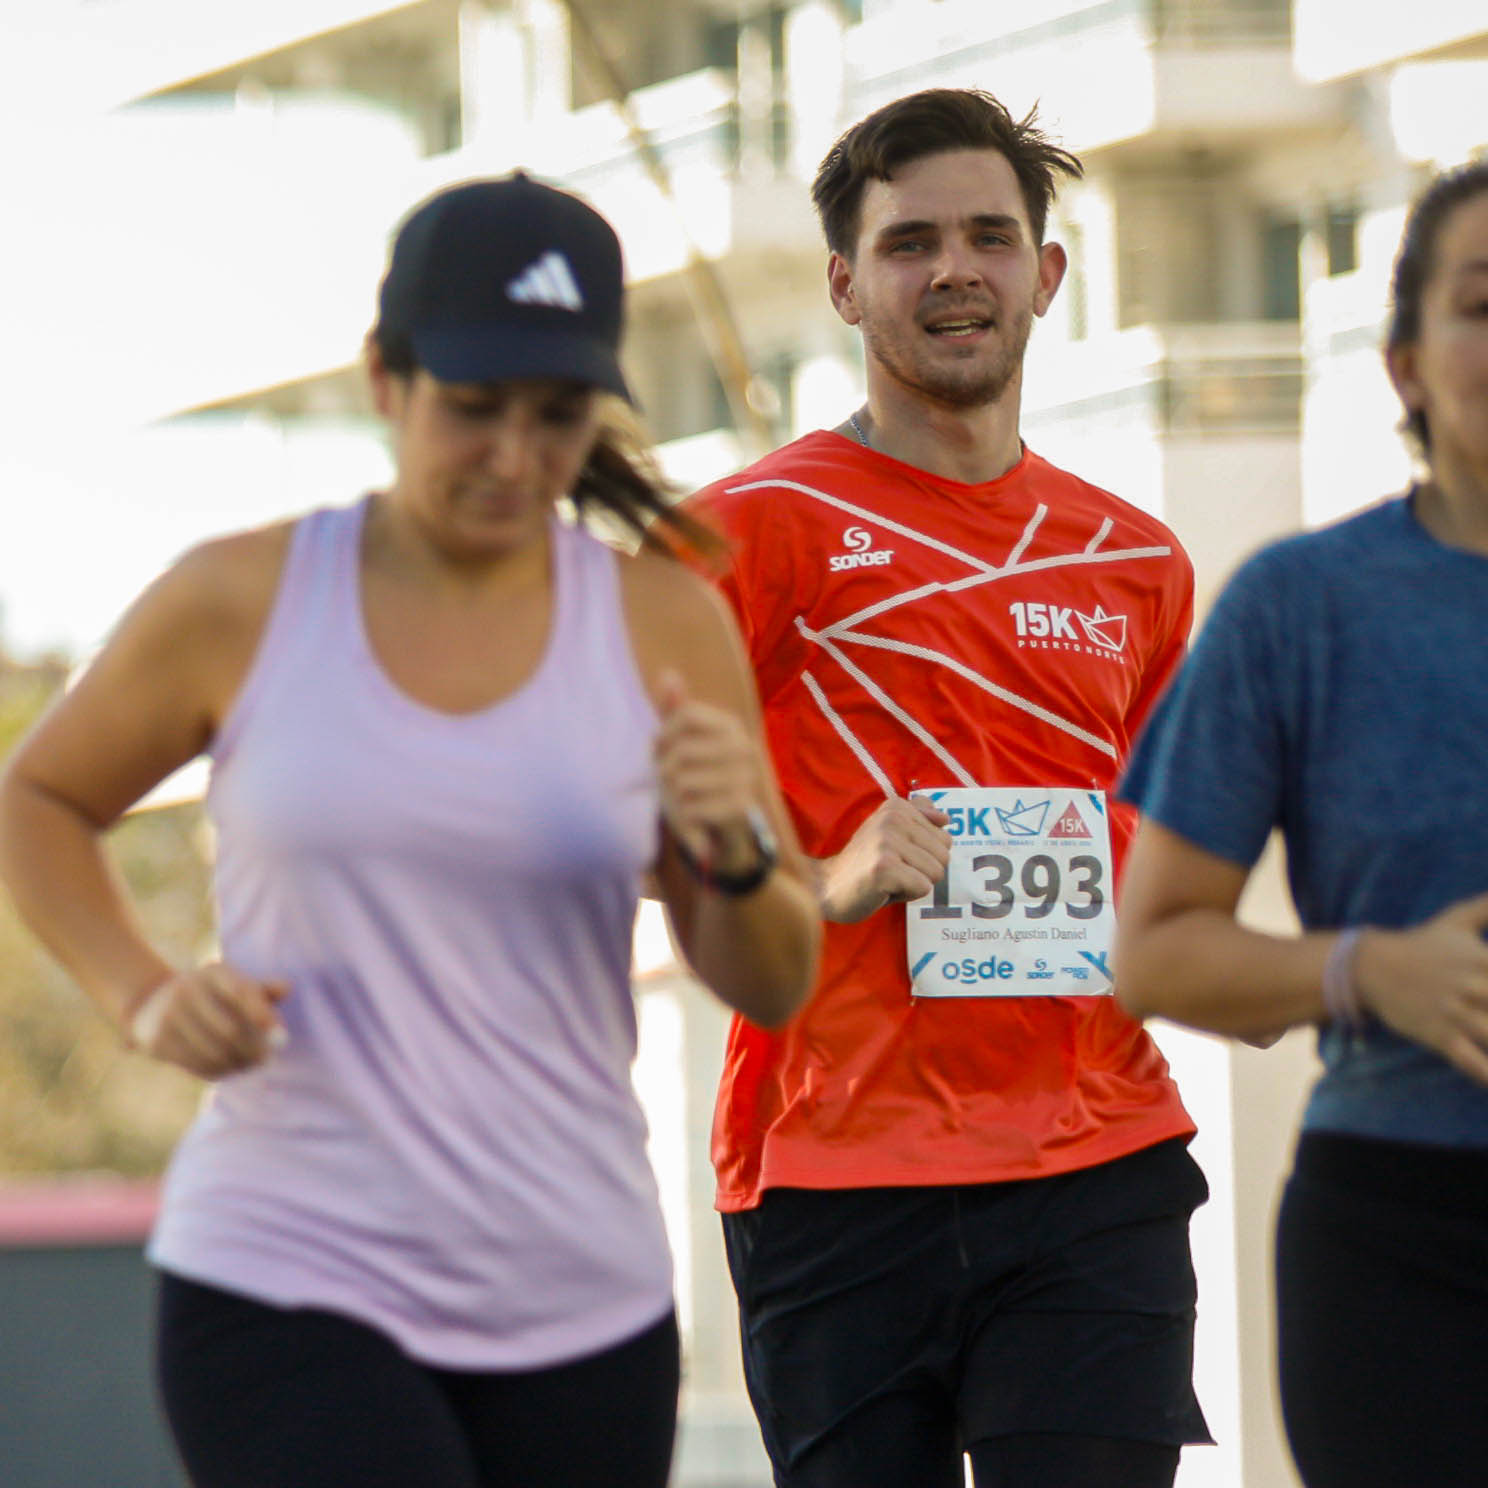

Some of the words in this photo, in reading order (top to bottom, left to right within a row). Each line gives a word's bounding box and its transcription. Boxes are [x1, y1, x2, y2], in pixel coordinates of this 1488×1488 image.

[1009, 602, 1079, 640] 15K
[1018, 640, 1080, 652] PUERTO
[936, 807, 992, 837] 5K
[1060, 818, 1084, 833] 15K
[920, 854, 1104, 919] 1393
[941, 927, 1000, 944] Sugliano
[1051, 927, 1087, 940] Daniel
[942, 955, 1014, 983] osde
